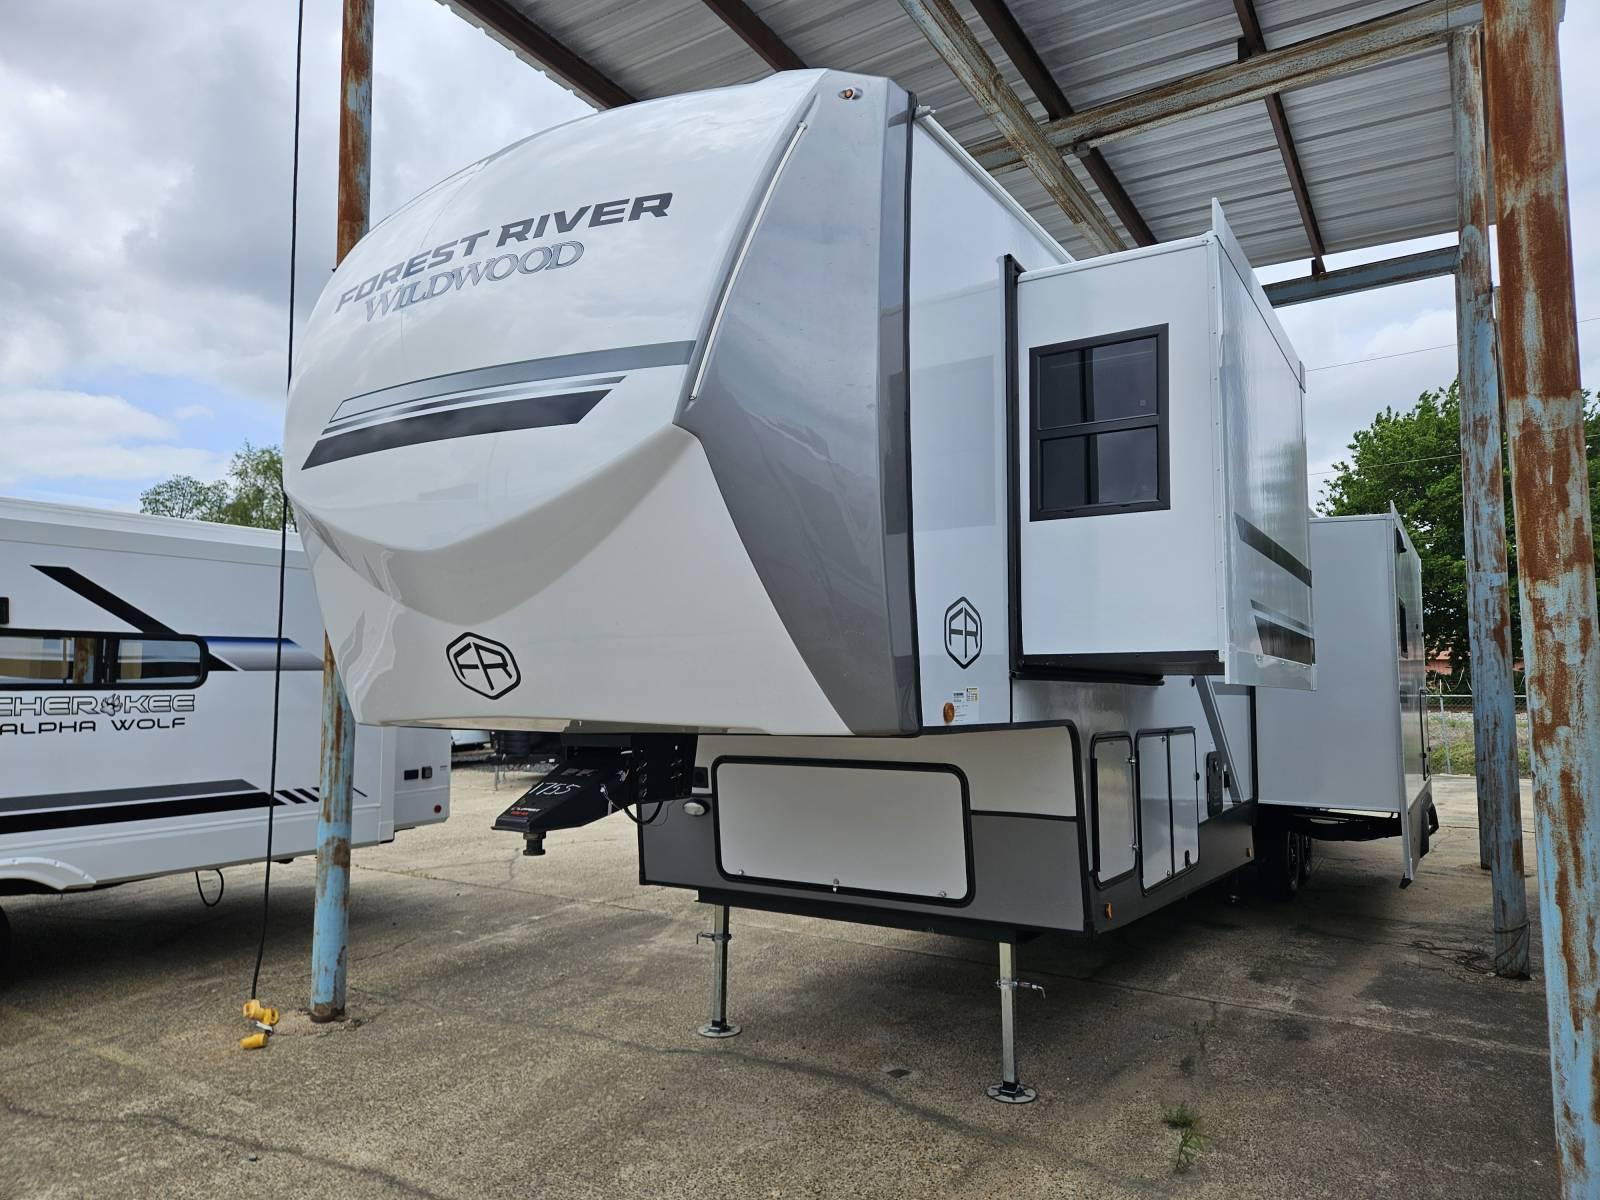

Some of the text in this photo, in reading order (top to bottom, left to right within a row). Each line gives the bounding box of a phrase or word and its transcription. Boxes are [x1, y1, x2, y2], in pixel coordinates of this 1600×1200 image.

[335, 192, 674, 314] FOREST RIVER
[364, 240, 585, 322] WILDWOOD
[0, 717, 186, 735] ALPHA WOLF
[528, 782, 582, 796] 1755
